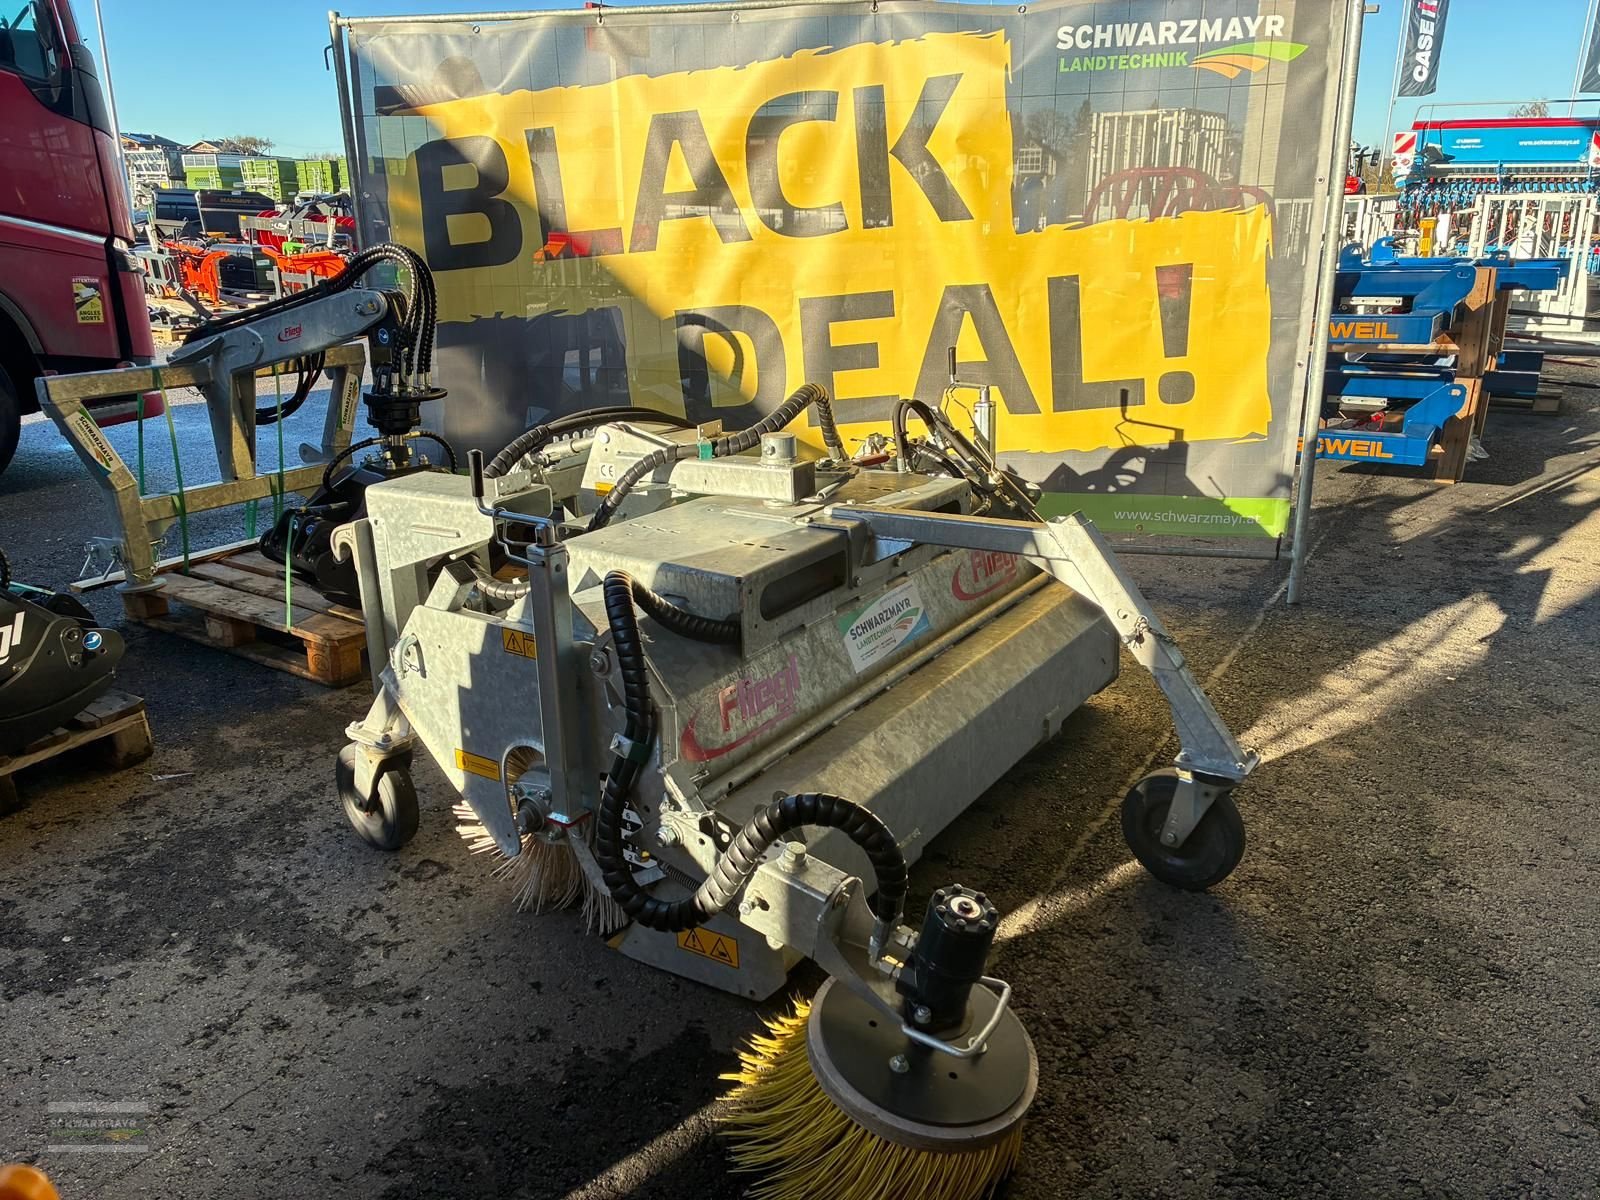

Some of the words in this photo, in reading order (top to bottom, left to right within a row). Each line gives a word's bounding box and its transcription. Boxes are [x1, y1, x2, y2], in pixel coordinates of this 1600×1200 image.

[1056, 15, 1286, 50] SCHWARZMAYR
[1413, 18, 1435, 83] CASE
[1059, 51, 1188, 73] LANDTECHNIK
[416, 73, 975, 272] BLACK
[675, 262, 1196, 433] DEAL!
[1329, 322, 1399, 339] WEIL
[79, 416, 114, 462] SCHWARZMAYR
[1114, 510, 1261, 527] www.schwarzmayr.at
[849, 598, 911, 641] SCHWARZMAYR
[856, 623, 895, 650] LANDTECHNIK
[719, 655, 800, 733] Fliegl
